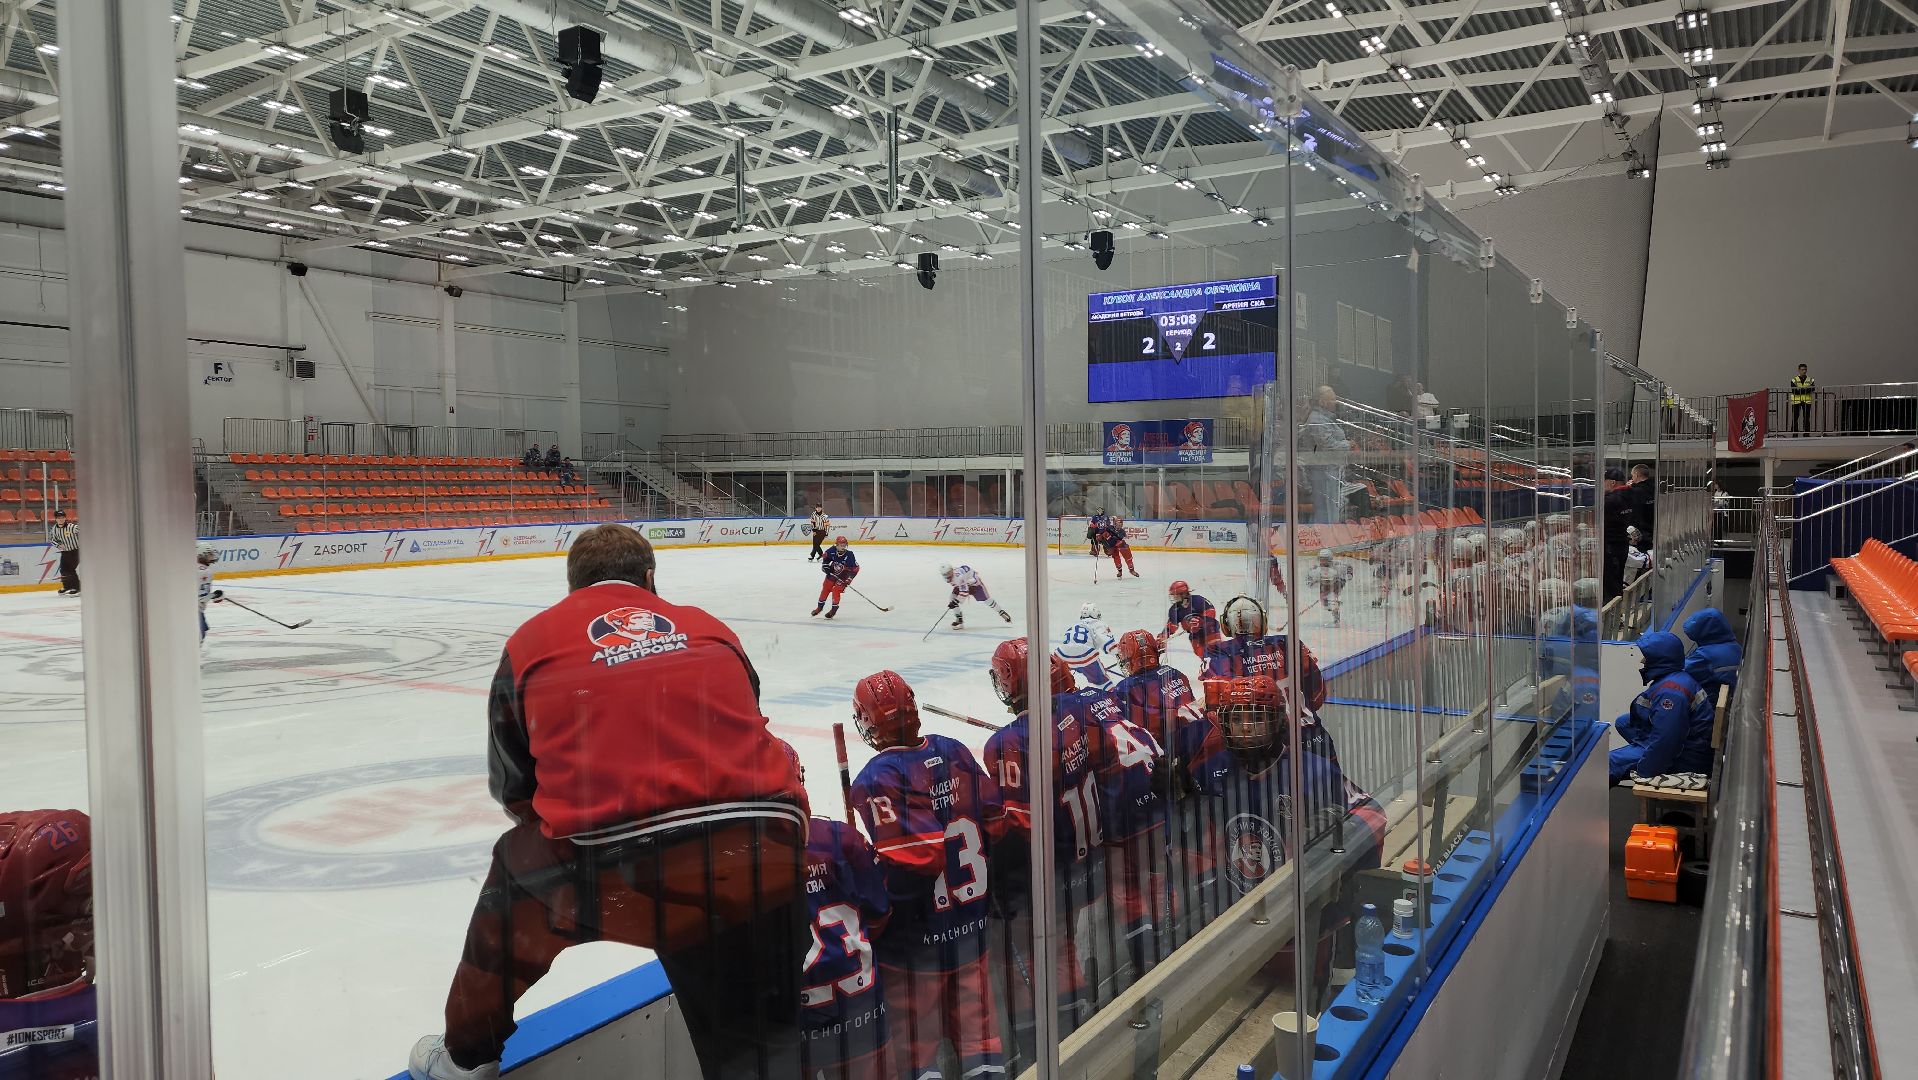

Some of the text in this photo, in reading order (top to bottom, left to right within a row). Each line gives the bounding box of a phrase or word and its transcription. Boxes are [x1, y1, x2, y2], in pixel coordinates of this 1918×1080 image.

[1250, 299, 1266, 307] СКА
[1160, 313, 1197, 328] 03:08
[1165, 328, 1193, 337] ПЕРИОД
[1202, 332, 1216, 350] 2
[1142, 336, 1155, 355] 2
[1175, 342, 1182, 351] 2
[213, 362, 223, 375] F
[313, 543, 368, 556] ZASPORT
[591, 633, 688, 663] АКАДЕМИЯ
[606, 642, 689, 667] ПЕТРОВА
[998, 759, 1021, 787] 10
[1136, 791, 1158, 807] КРА
[866, 796, 898, 826] 13
[44, 820, 81, 850] 26
[1443, 832, 1464, 860] BLACK
[933, 814, 989, 913] 13
[923, 914, 988, 945] КРАСНОГО
[801, 1001, 886, 1041] АСНОГОРСК
[6, 1027, 67, 1046] #IONESPORT
